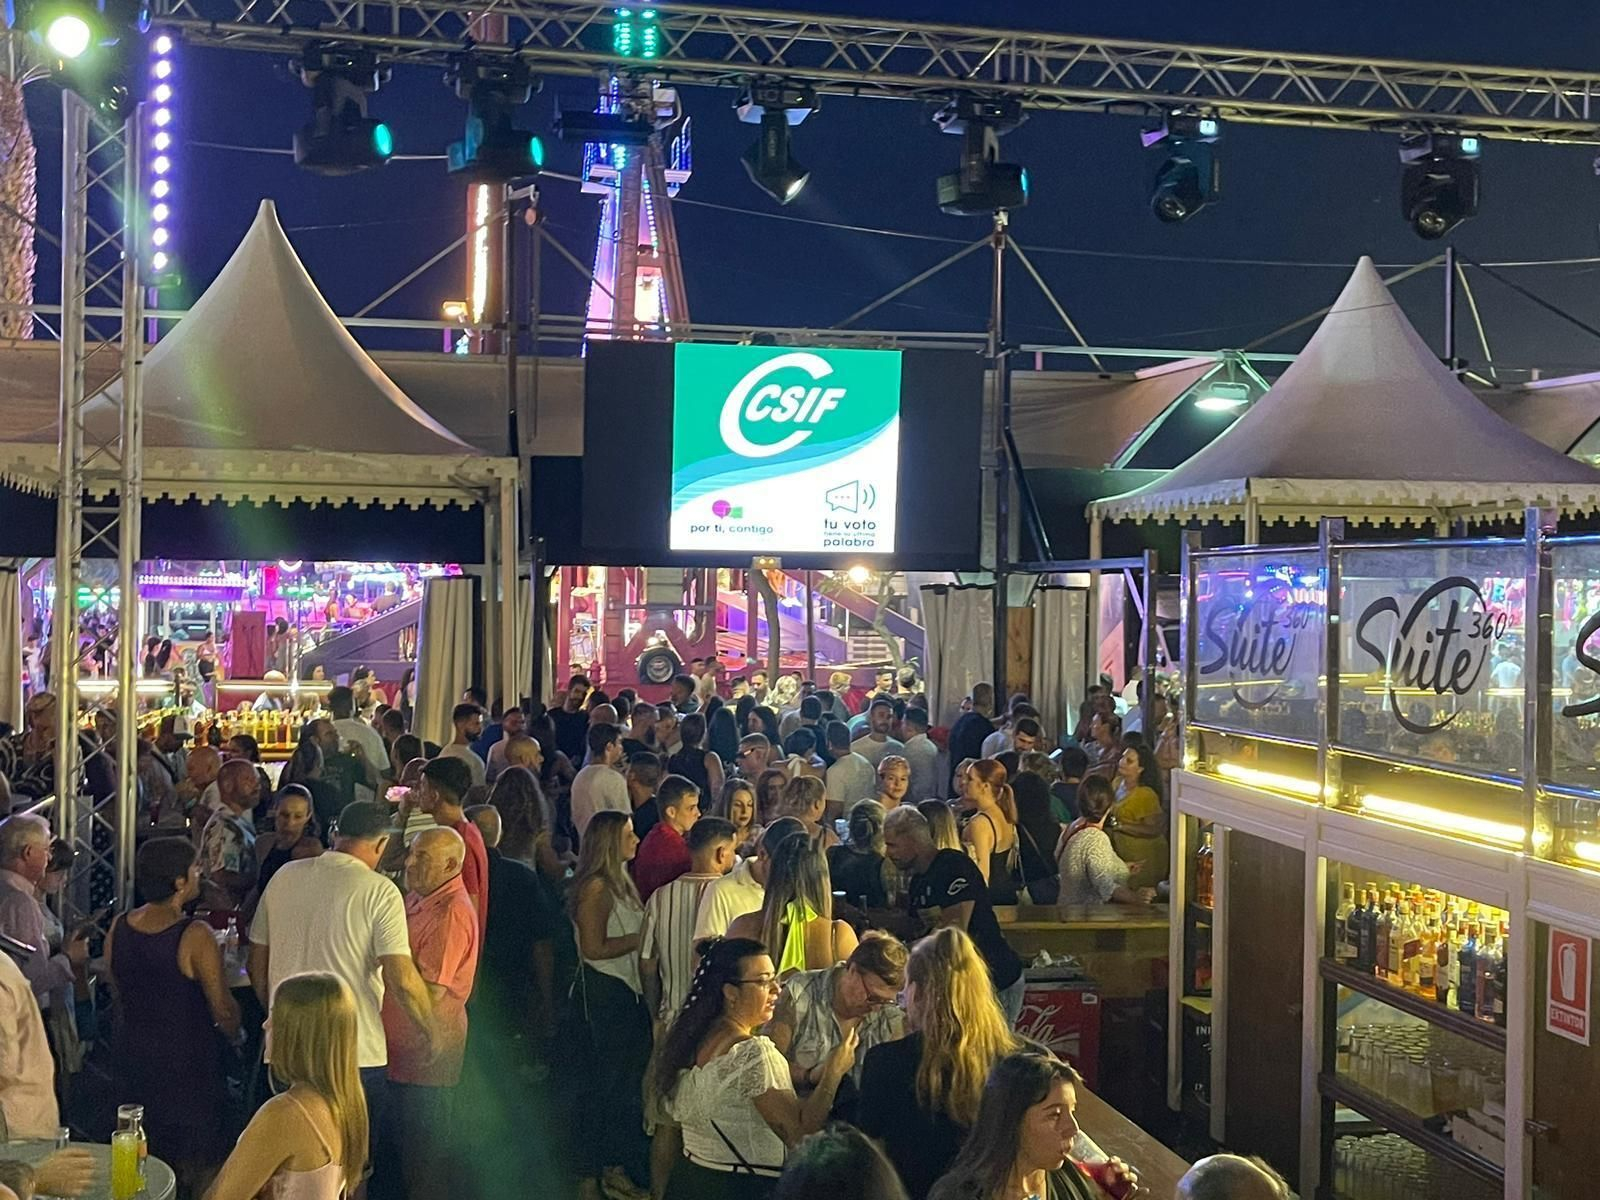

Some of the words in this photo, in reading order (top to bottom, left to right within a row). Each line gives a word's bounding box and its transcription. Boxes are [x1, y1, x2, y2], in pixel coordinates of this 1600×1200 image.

[744, 383, 847, 424] CSIF
[690, 524, 711, 534] por
[714, 523, 726, 534] ti,
[729, 525, 774, 536] contigo
[824, 517, 838, 530] tu
[843, 519, 877, 530] voto
[823, 537, 875, 547] palabra
[1199, 588, 1297, 692] Suite
[1354, 582, 1488, 715] Suite
